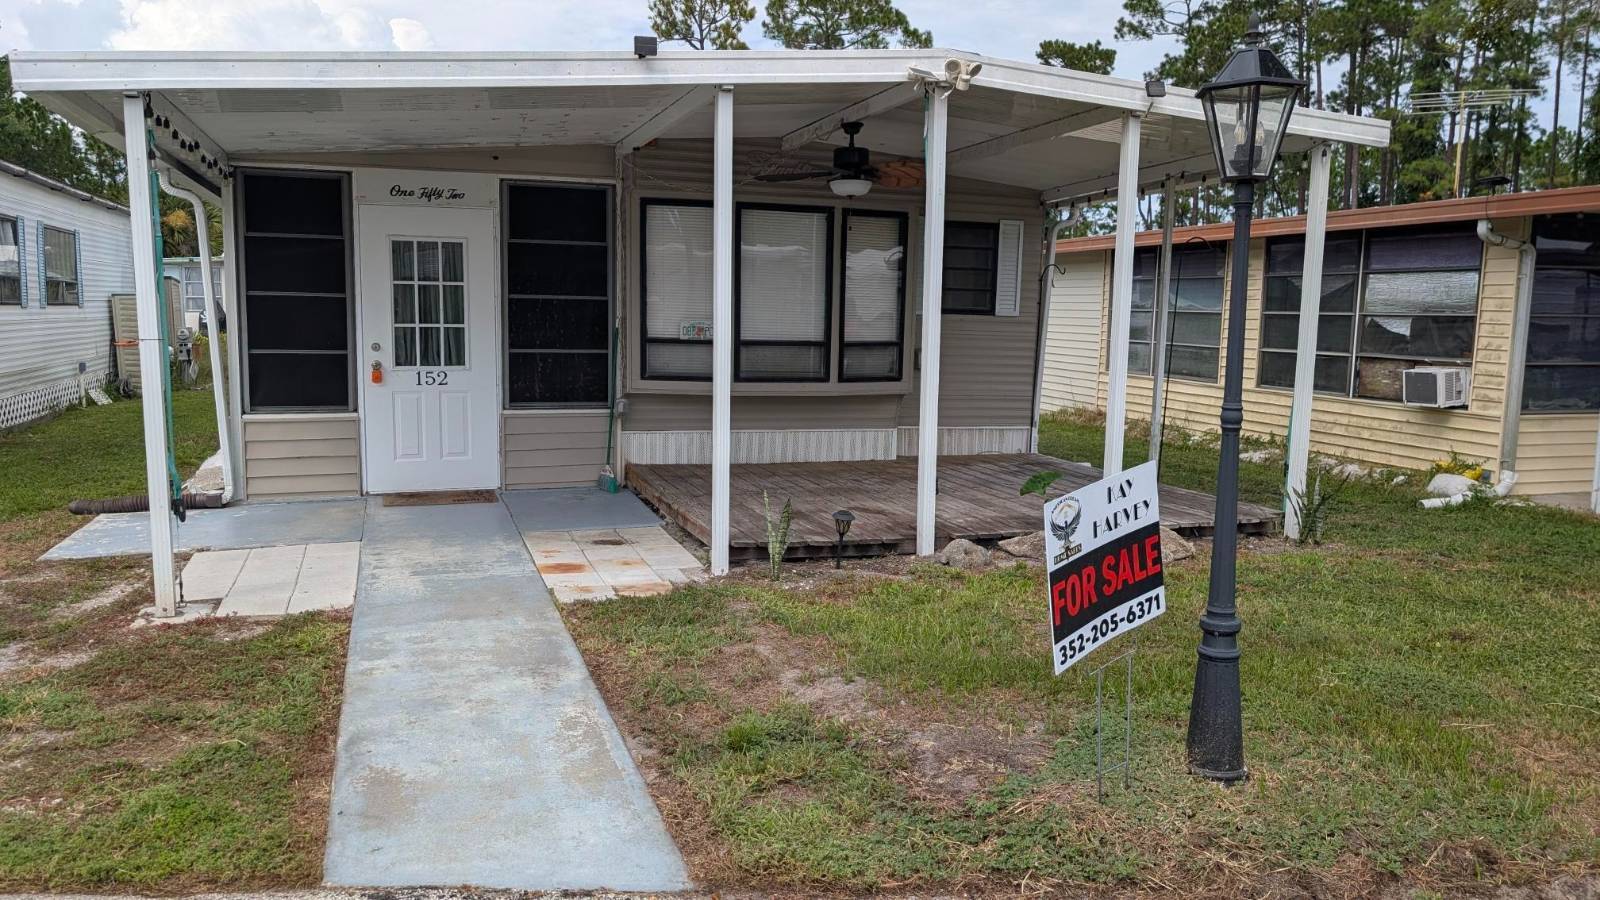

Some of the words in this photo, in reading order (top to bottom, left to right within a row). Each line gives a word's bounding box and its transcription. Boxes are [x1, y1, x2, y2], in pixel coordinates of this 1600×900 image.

[390, 184, 415, 197] One
[417, 187, 445, 202] Fifty
[446, 188, 465, 200] Two
[415, 370, 448, 386] 152
[1107, 477, 1135, 504] KAY
[1093, 498, 1152, 539] HARVEY
[1052, 565, 1098, 626] FOR
[1102, 534, 1161, 596] SALE
[1059, 592, 1161, 666] 352-205-6371
